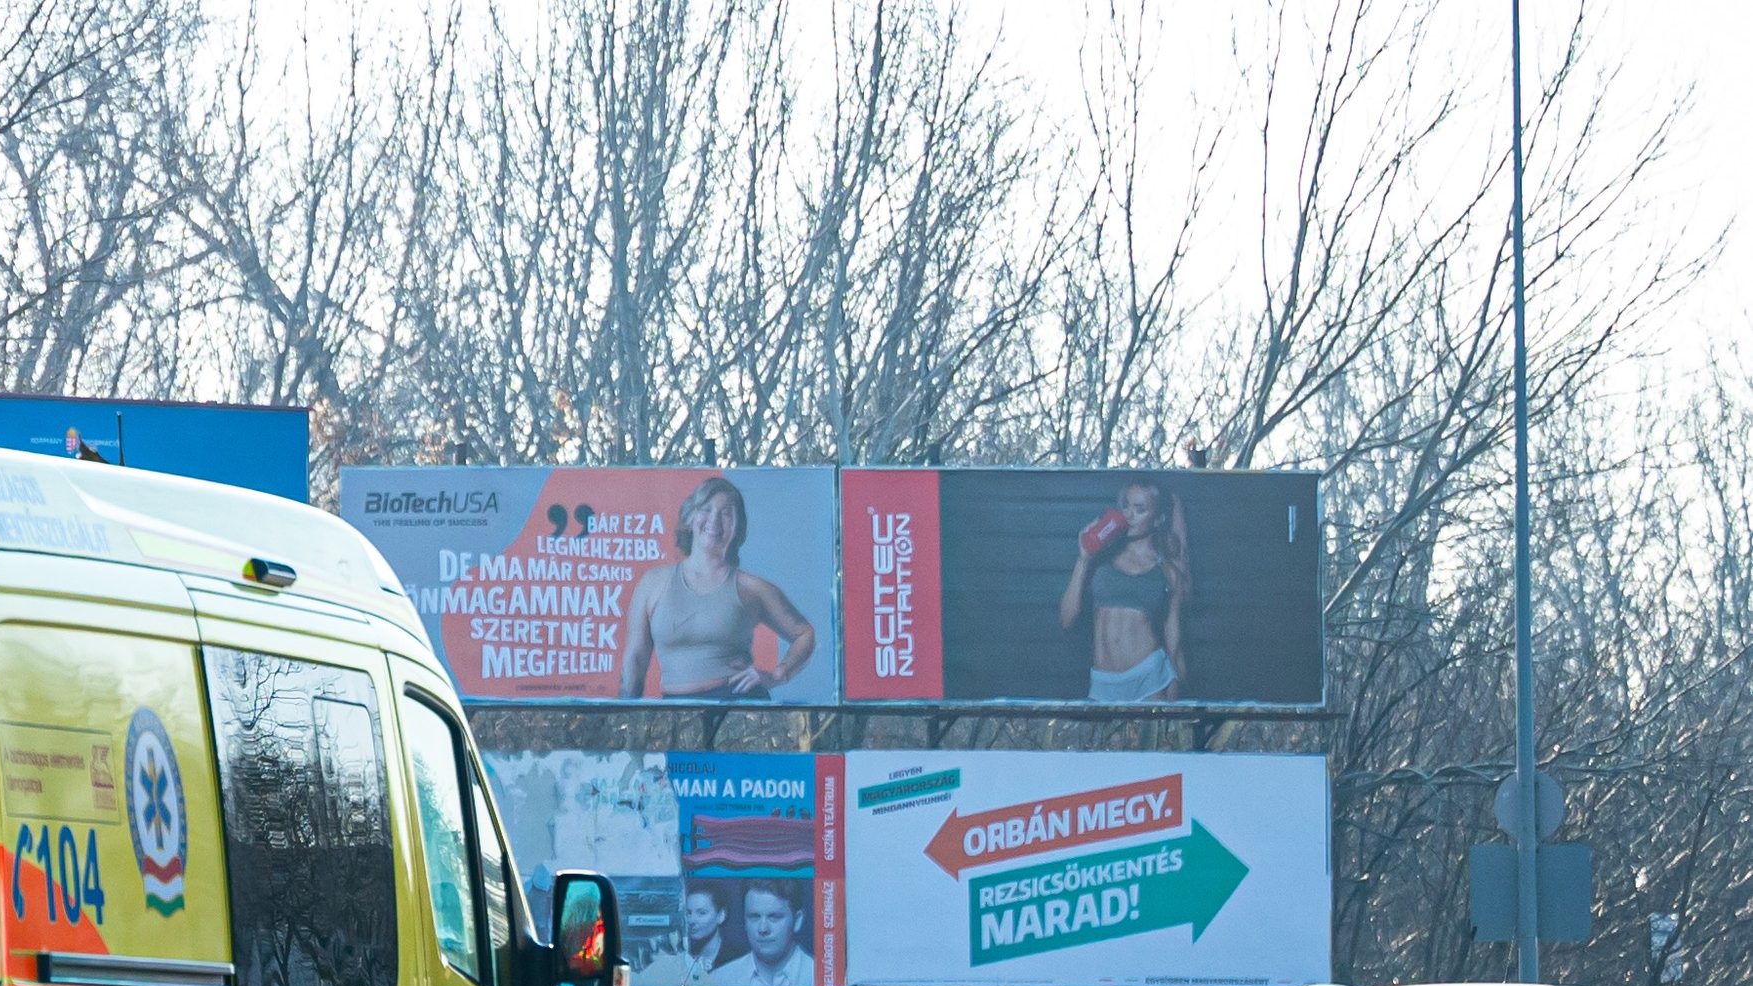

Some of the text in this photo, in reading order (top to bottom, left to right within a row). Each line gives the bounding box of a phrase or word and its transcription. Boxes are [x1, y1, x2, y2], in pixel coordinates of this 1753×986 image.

[365, 491, 499, 514] BioTechUSA
[393, 518, 430, 527] FEELING
[433, 518, 446, 527] OF
[448, 518, 488, 527] SUCCESS
[587, 512, 664, 535] BÁR EZ A
[439, 549, 633, 582] DE MA MÁR CSAKIS
[406, 584, 622, 617] ÖNMAGAMNAK
[872, 514, 896, 678] SCITEC
[895, 514, 914, 677] NUTRITION
[470, 616, 617, 650] SZERETNÉK
[482, 644, 613, 679] MEGFELELNI
[673, 778, 805, 799] MAN A PADON
[889, 766, 923, 780] LEGYEN
[822, 776, 835, 828] TEÁTRUM
[963, 789, 1173, 857] ORBÁN MEGY.
[37, 824, 105, 926] 104
[979, 845, 1183, 910] REZSICSÖKKENTÉS
[822, 880, 834, 929] SZÍNHÁZ
[980, 883, 1140, 951] MARAD!
